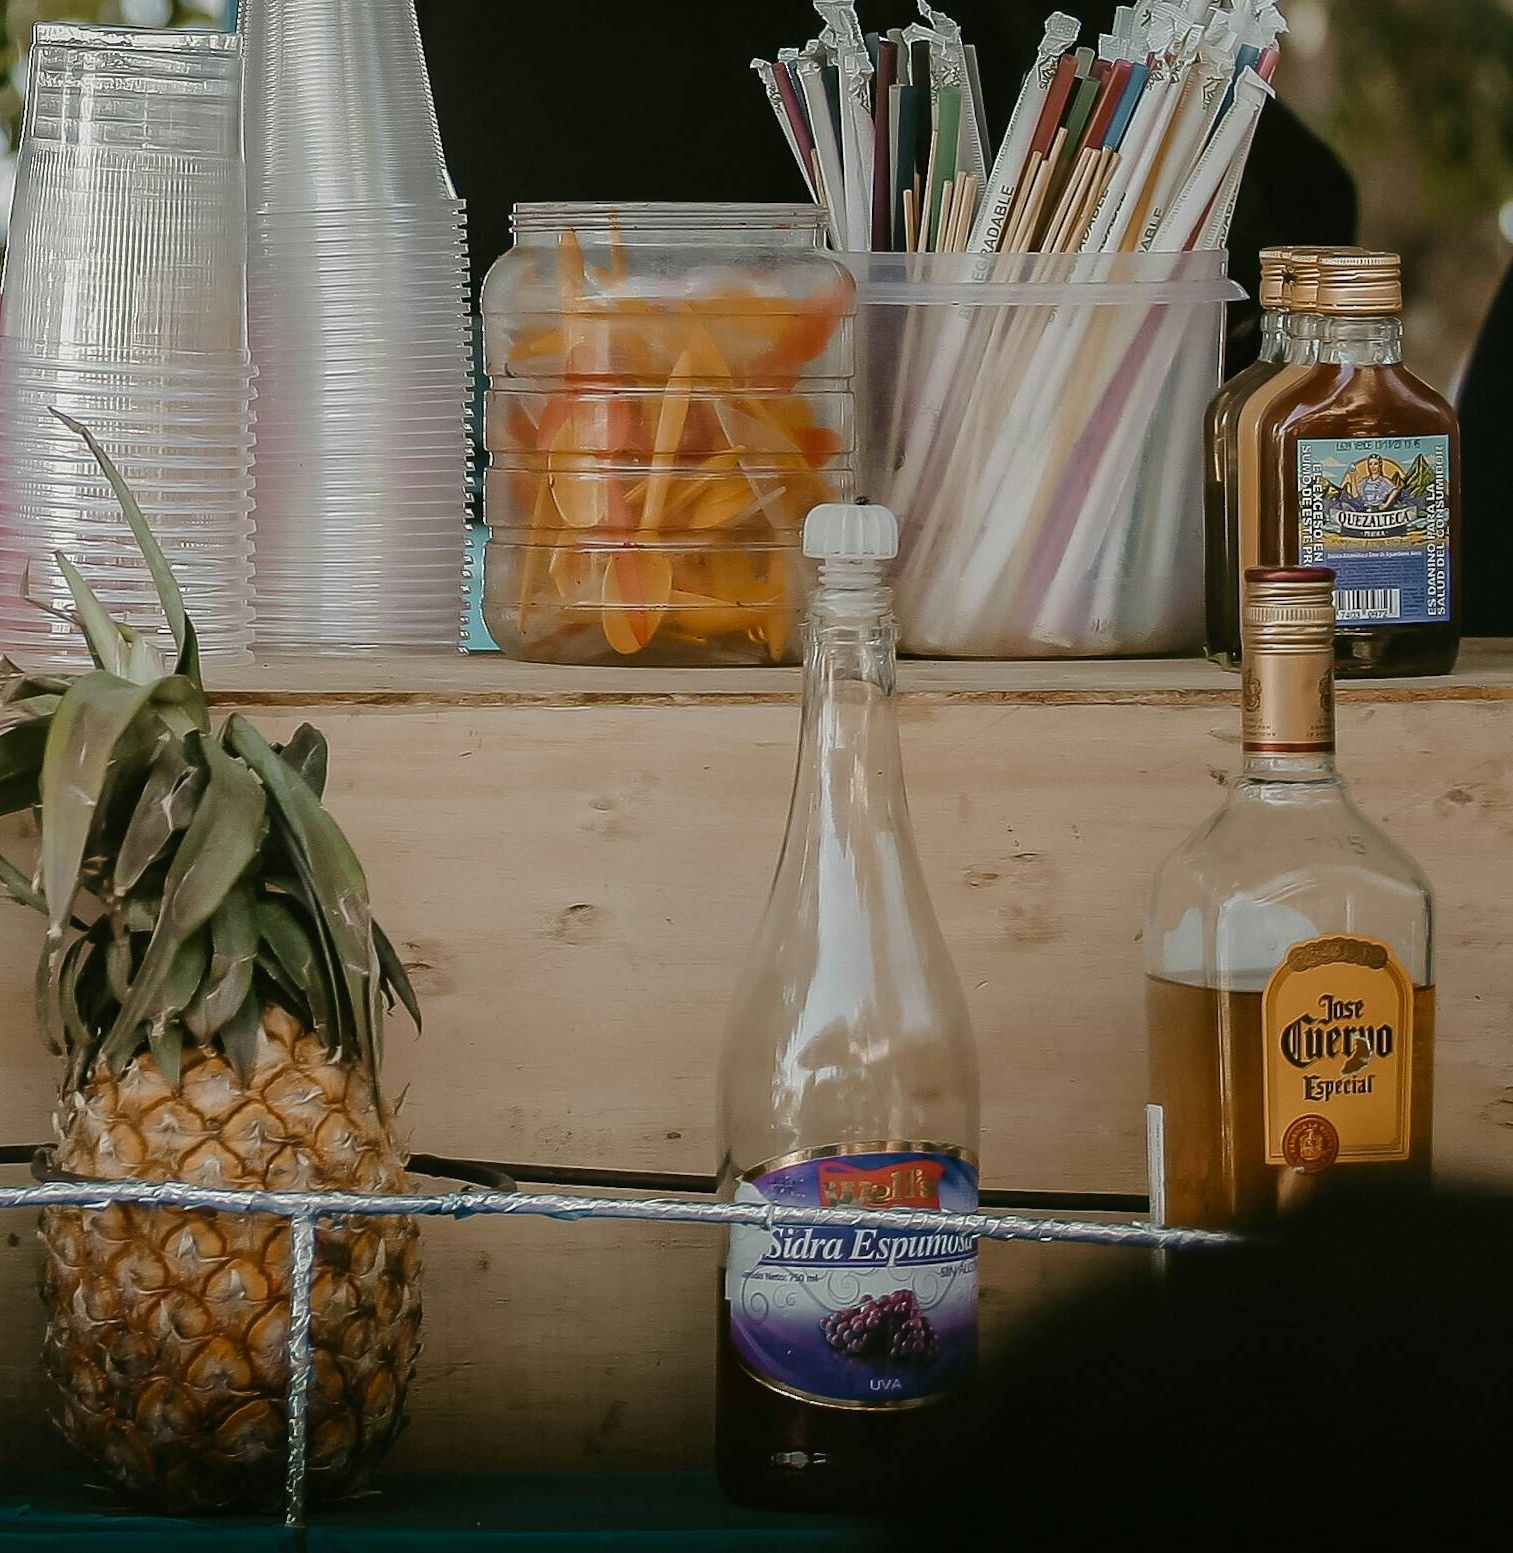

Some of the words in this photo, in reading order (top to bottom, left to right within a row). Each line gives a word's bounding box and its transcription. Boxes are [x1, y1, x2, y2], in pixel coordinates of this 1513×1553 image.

[1301, 488, 1313, 505] DE
[1425, 484, 1436, 503] LA
[1435, 446, 1446, 541] CONSUMIDOR
[1312, 483, 1323, 540] EXCESO
[1338, 508, 1412, 529] QUEZALTECA
[1426, 503, 1436, 542] PARA
[1301, 506, 1313, 545] ESTE
[1312, 542, 1323, 562] EN
[1436, 543, 1446, 569] DEL
[1436, 572, 1446, 615] SALUD
[1426, 603, 1437, 616] ES
[1318, 994, 1365, 1025] Jose
[1303, 1074, 1376, 1101] Especial
[765, 1227, 843, 1261] Sidra
[869, 1378, 902, 1391] UVA
